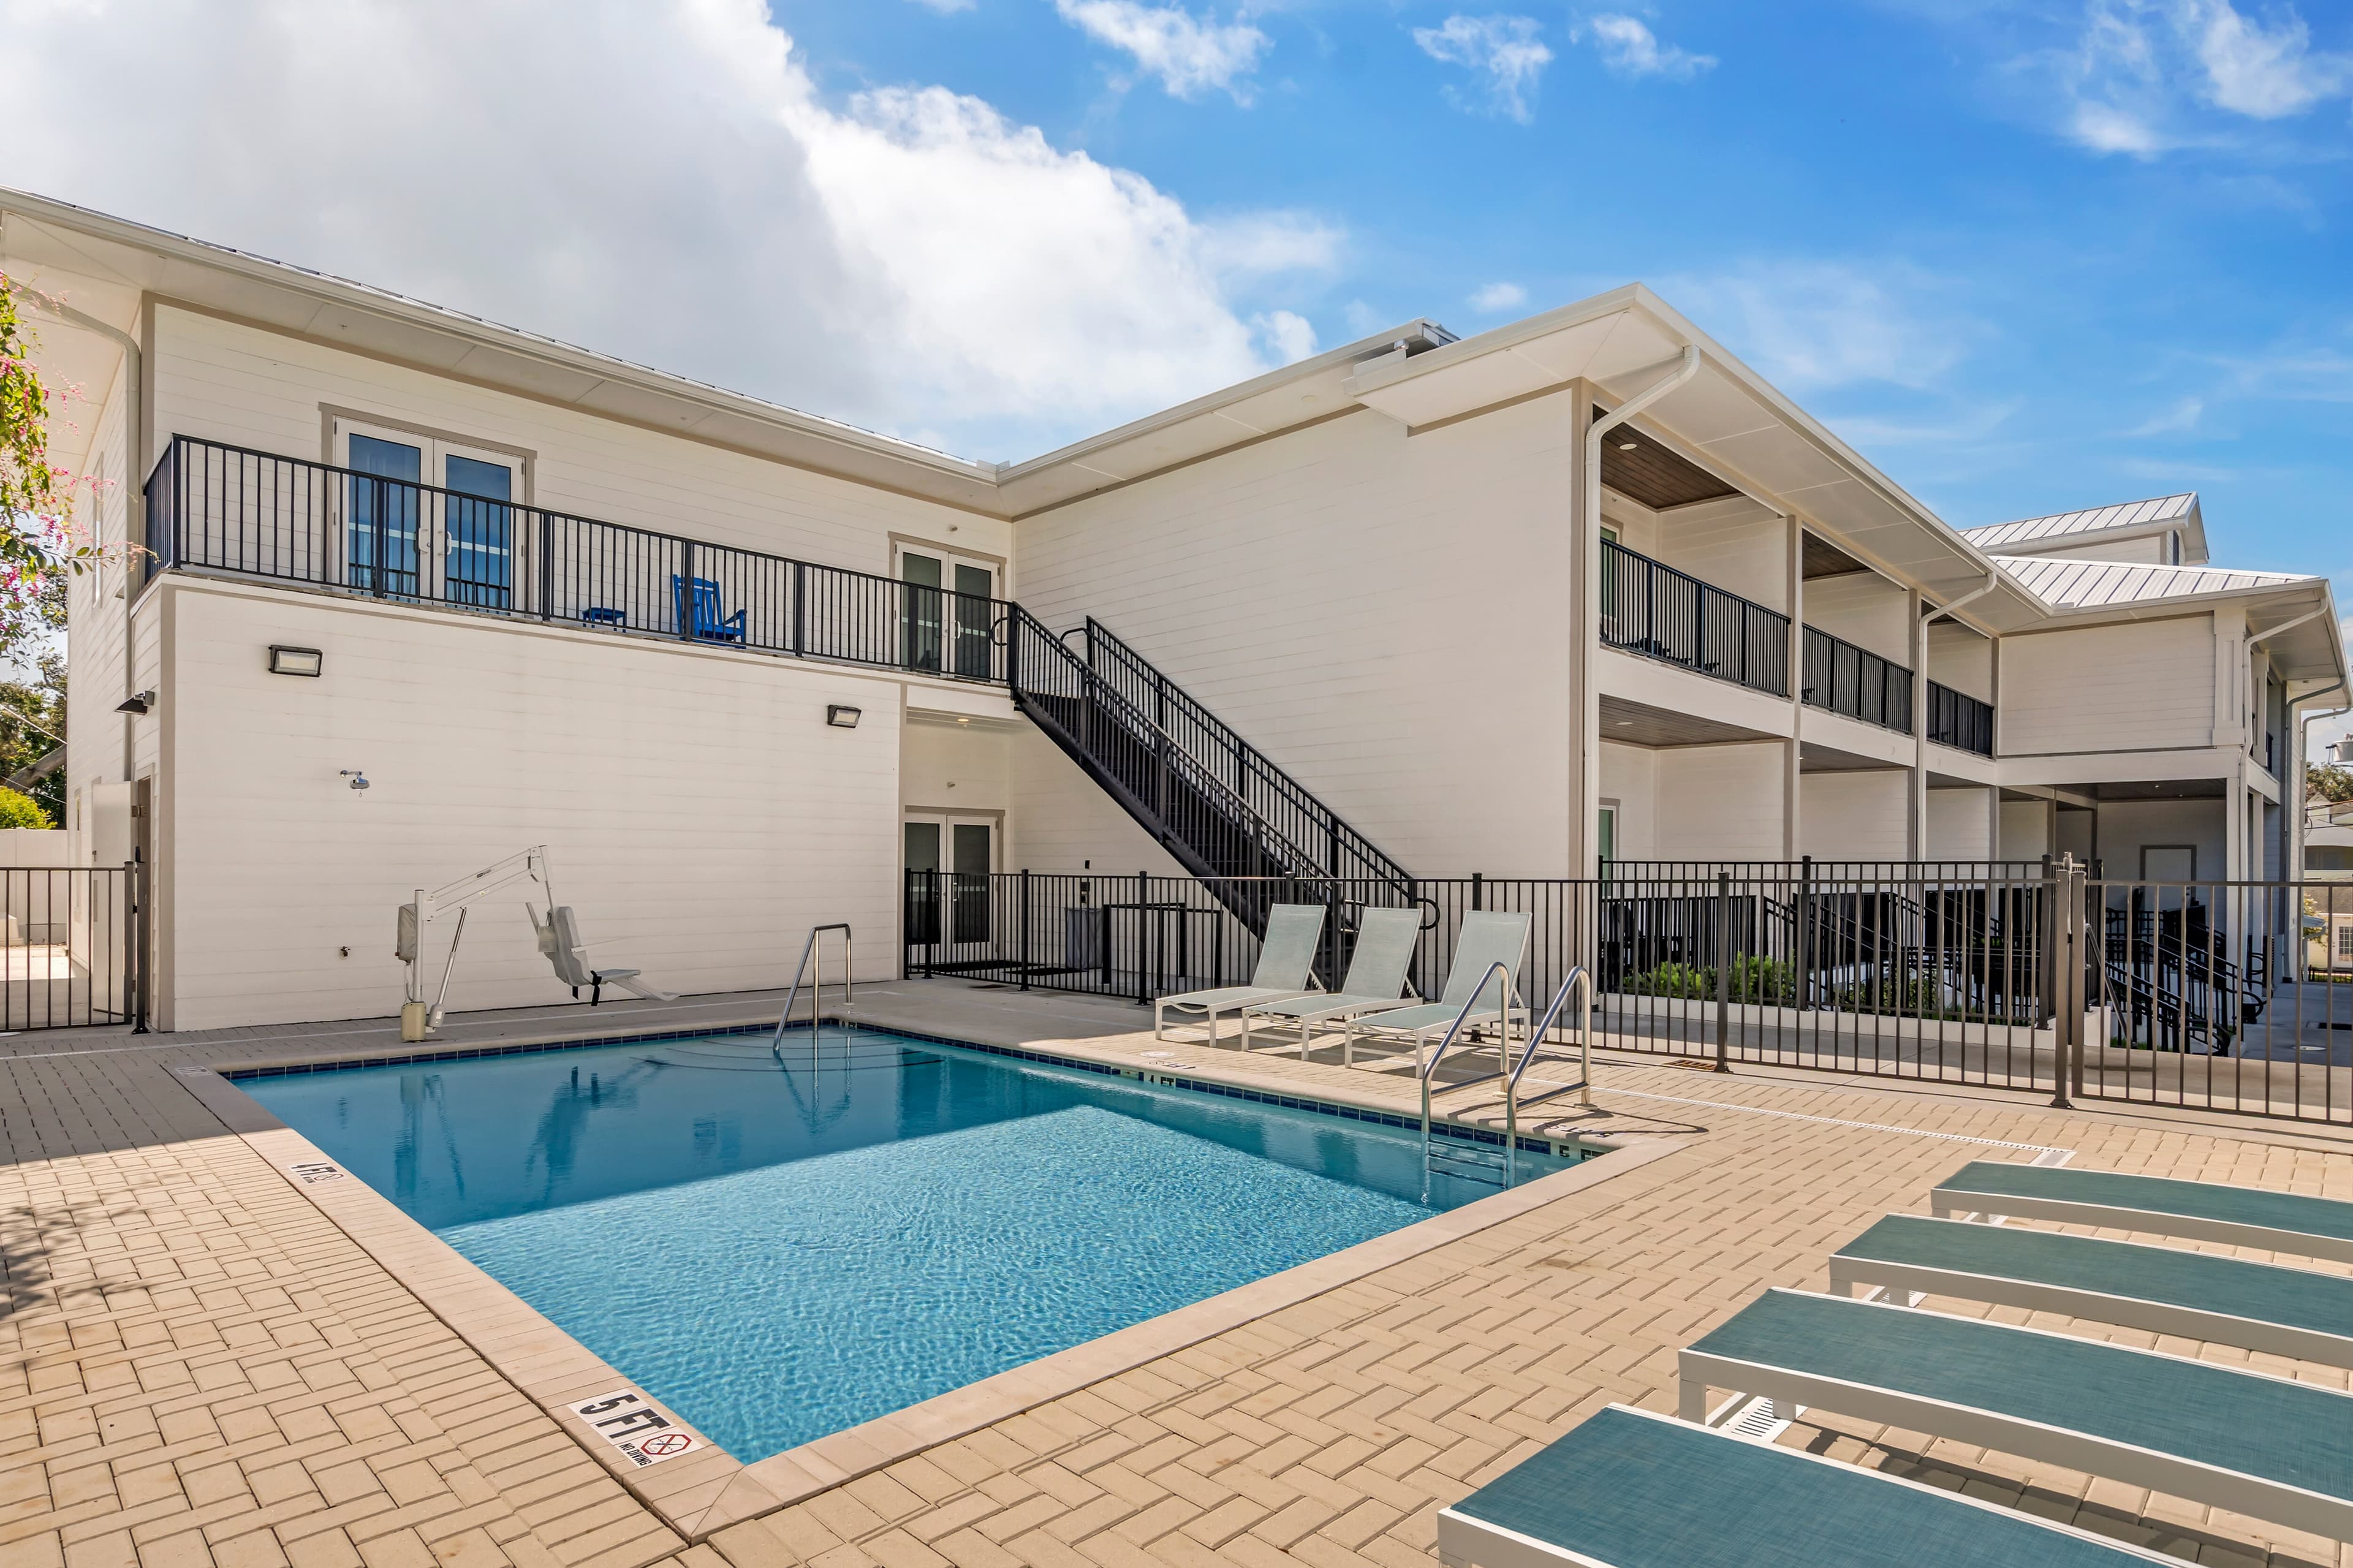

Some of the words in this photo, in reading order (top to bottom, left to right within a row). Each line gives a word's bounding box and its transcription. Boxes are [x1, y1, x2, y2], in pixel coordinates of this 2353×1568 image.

[1161, 1077, 1174, 1086] FT
[1559, 1145, 1570, 1157] 5
[297, 1167, 337, 1176] FT
[579, 1393, 639, 1415] 5
[596, 1408, 671, 1439] FT
[619, 1442, 635, 1451] NO
[626, 1449, 652, 1466] DIVING
